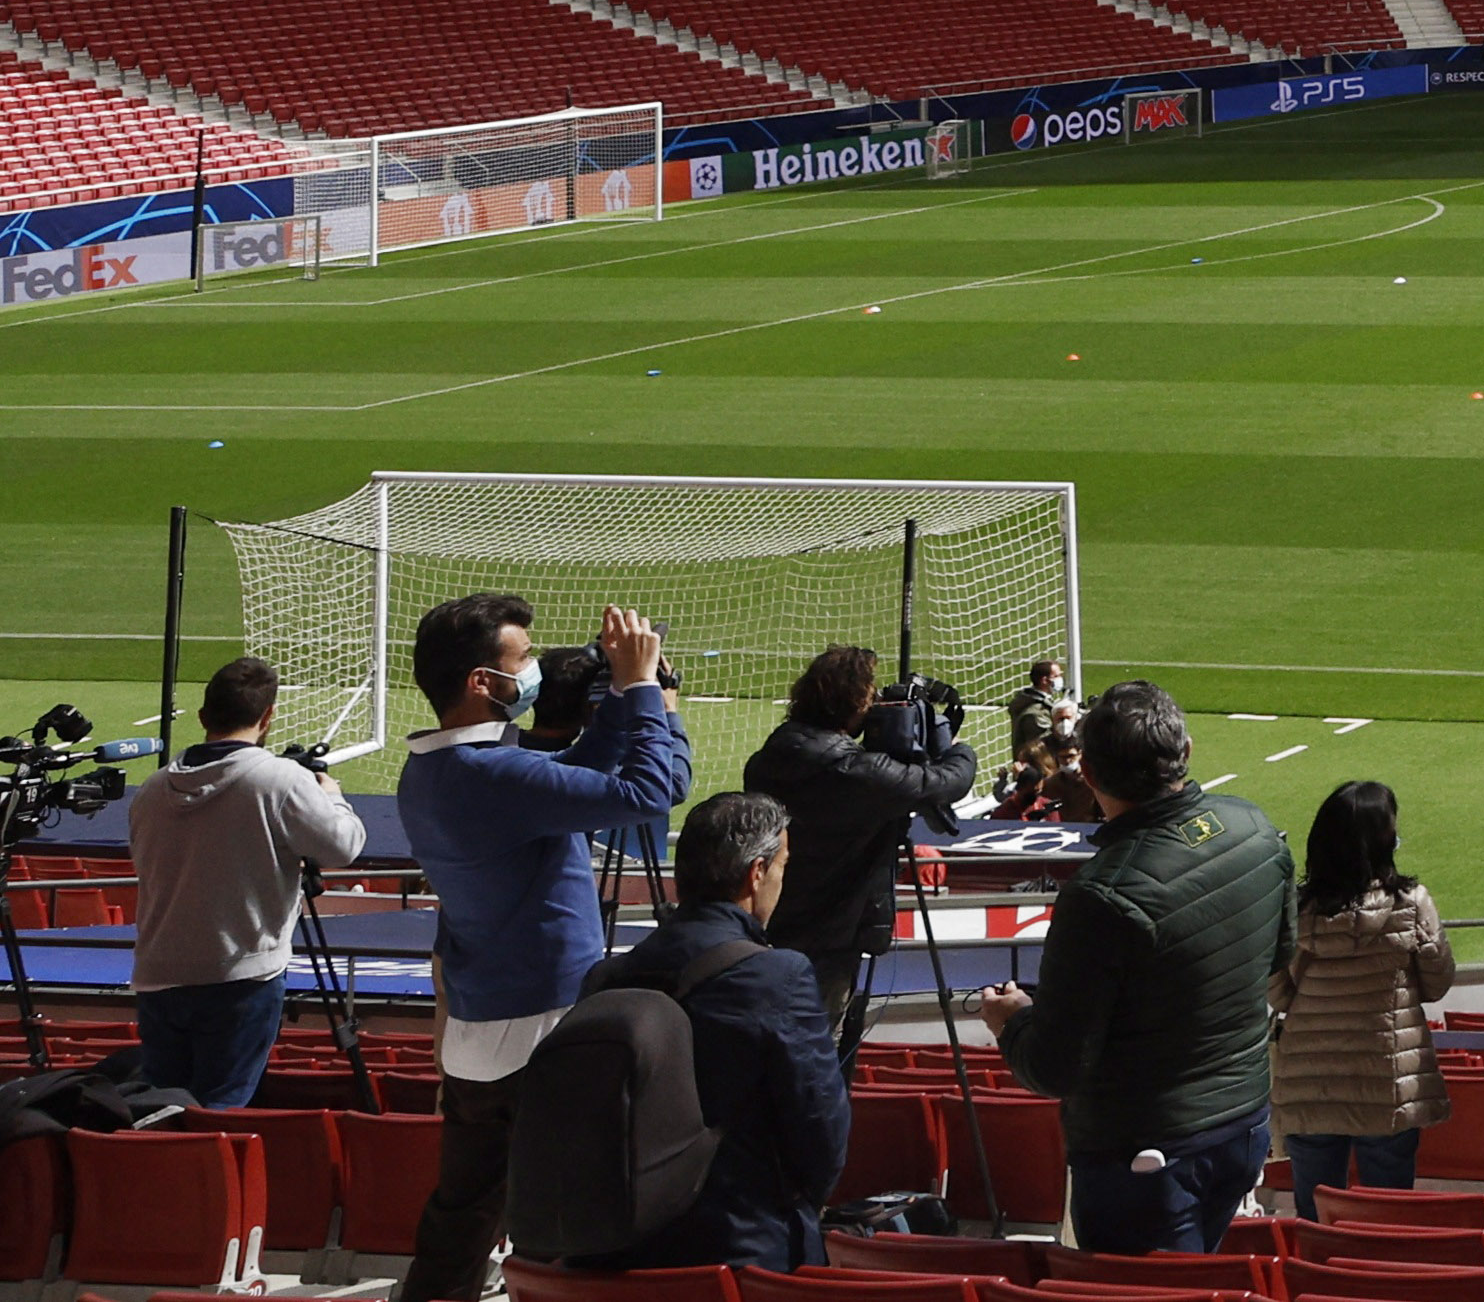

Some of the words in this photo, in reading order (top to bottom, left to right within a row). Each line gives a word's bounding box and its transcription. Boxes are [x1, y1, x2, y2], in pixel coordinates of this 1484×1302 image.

[1134, 94, 1188, 132] MAX
[1302, 76, 1365, 105] PS5
[753, 133, 925, 191] Heineken
[3, 245, 138, 304] FedEx
